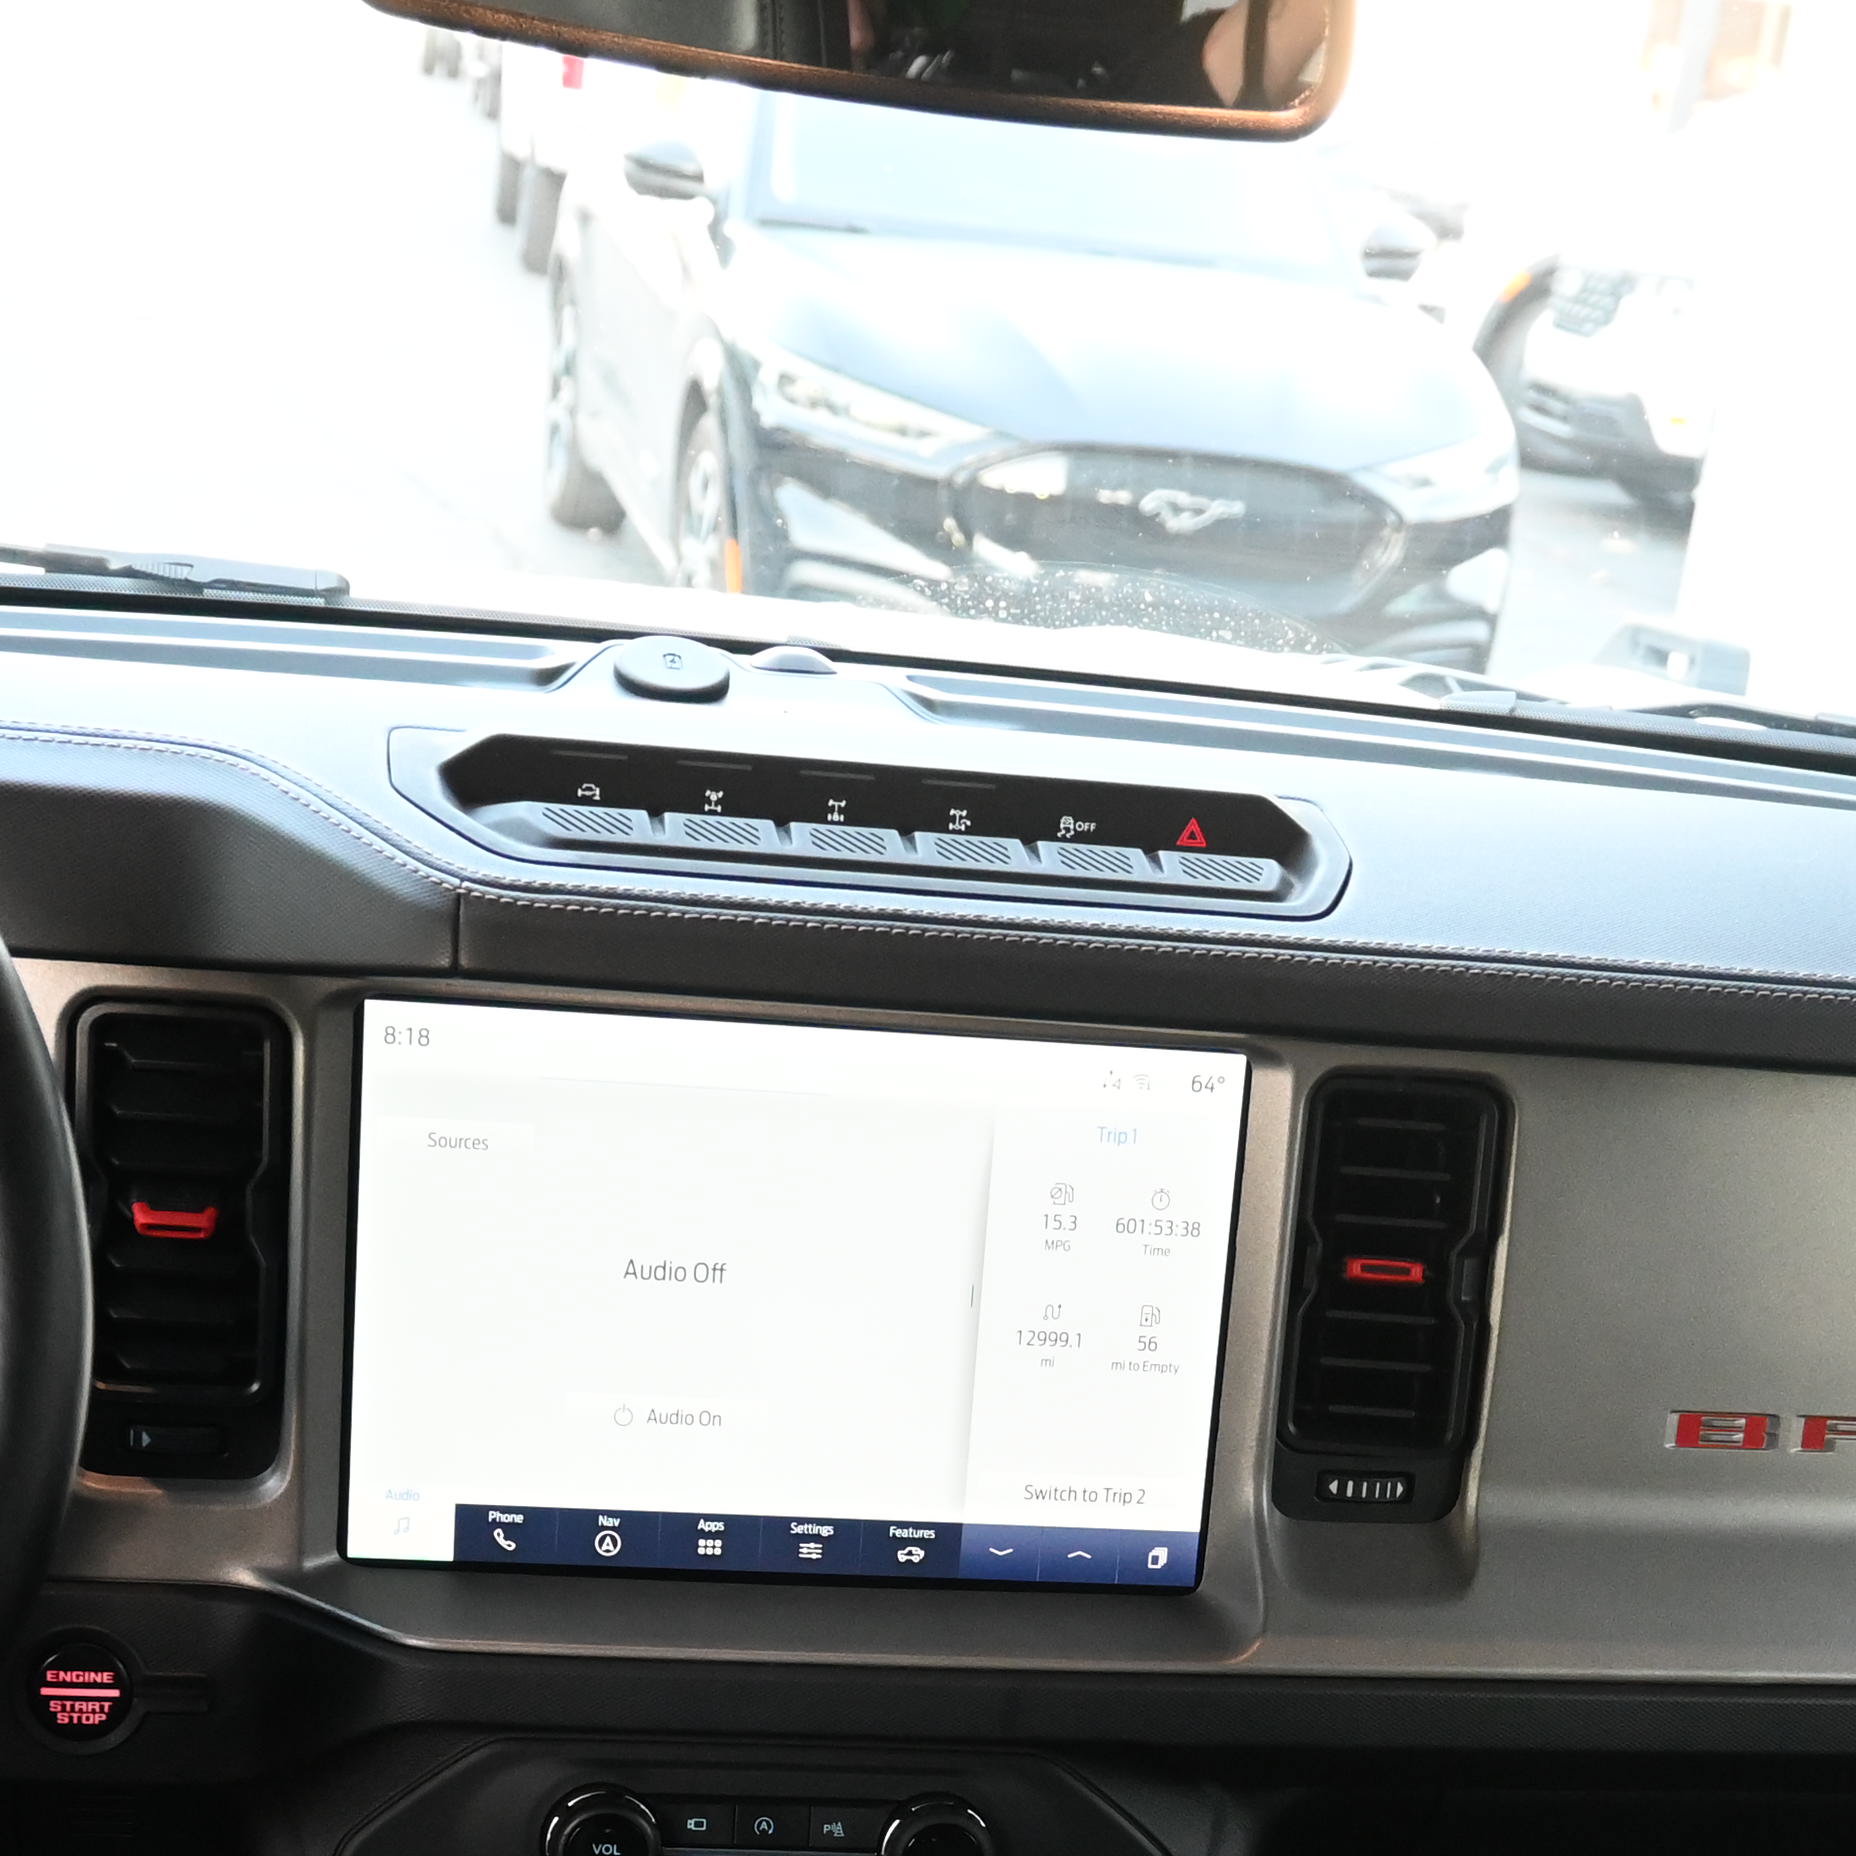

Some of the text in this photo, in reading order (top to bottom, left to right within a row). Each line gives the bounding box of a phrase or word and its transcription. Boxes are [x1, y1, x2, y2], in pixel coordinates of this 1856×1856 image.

[1075, 821, 1097, 832] OFF
[383, 1025, 431, 1047] 8:18
[1191, 1075, 1225, 1093] 64°
[427, 1132, 489, 1151] Sources
[1097, 1126, 1137, 1146] Trip 1
[1043, 1214, 1077, 1231] 15.3
[1115, 1218, 1201, 1237] 601:53:38
[1044, 1239, 1071, 1252] MPG
[1143, 1244, 1171, 1257] Time
[624, 1259, 728, 1284] Audio Off
[1016, 1330, 1082, 1348] 12999.1
[1137, 1335, 1158, 1352] 56
[1040, 1357, 1055, 1368] mi
[1111, 1361, 1180, 1375] mi to Empty
[647, 1408, 722, 1427] Audio On
[386, 1489, 420, 1501] Audio
[1024, 1484, 1146, 1505] Switch to Trip 2
[488, 1511, 524, 1525] Phone
[598, 1515, 620, 1527] Nav
[697, 1519, 725, 1533] Apps
[790, 1522, 834, 1537] Settings
[889, 1526, 936, 1539] Features
[46, 1670, 115, 1683] ENGINE
[49, 1700, 113, 1713] START
[56, 1712, 107, 1725] STOP
[593, 1844, 621, 1856] VOL
